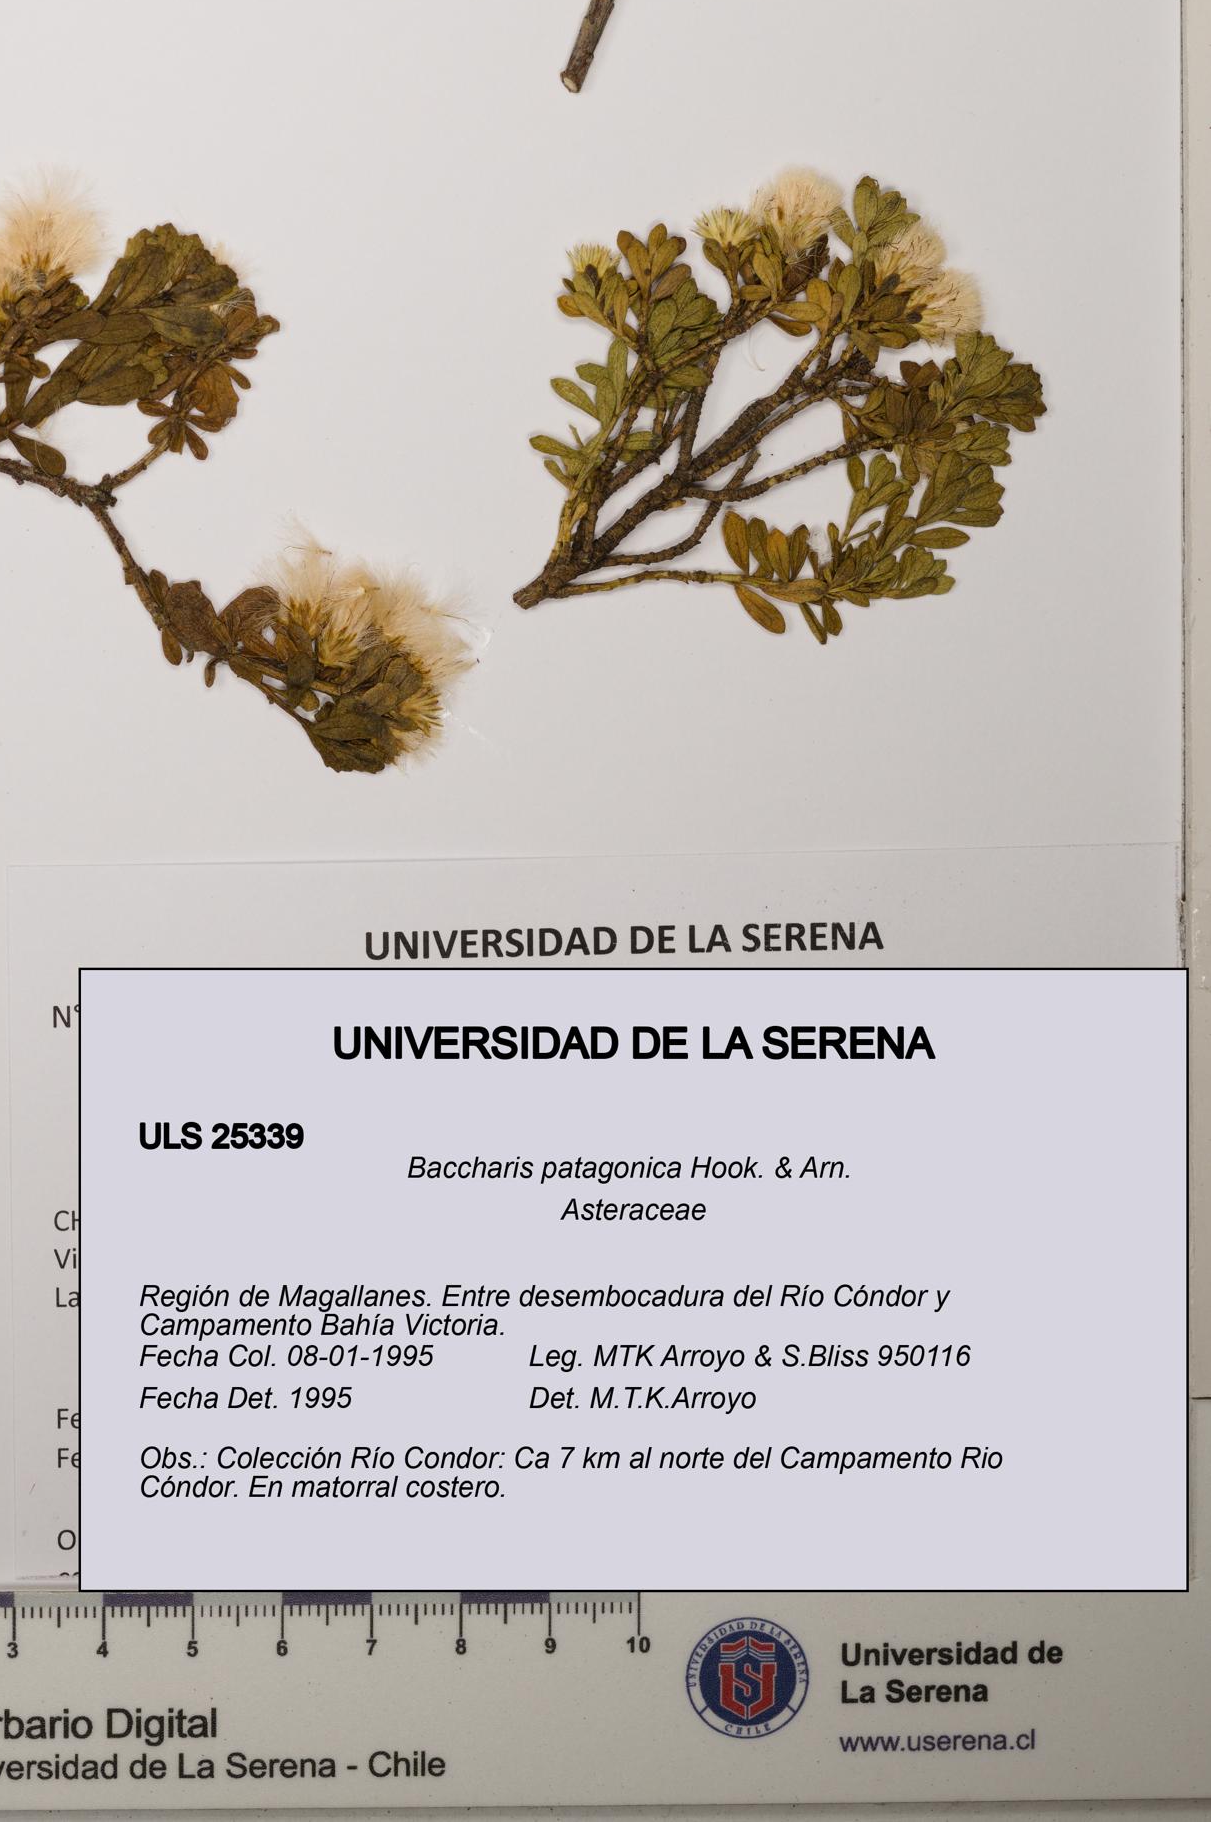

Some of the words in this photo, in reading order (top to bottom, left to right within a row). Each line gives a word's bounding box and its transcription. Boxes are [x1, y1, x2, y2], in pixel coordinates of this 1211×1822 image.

[365, 926, 618, 961] UNIVERSIDAD
[630, 924, 676, 955] DE
[688, 924, 732, 954] LA
[742, 921, 884, 953] SERENA
[6, 1641, 19, 1659] 3
[96, 1641, 110, 1659] 4
[186, 1640, 199, 1658] 5
[276, 1639, 289, 1657] 6
[365, 1638, 378, 1656] 7
[454, 1637, 467, 1656] 8
[544, 1636, 557, 1655] 9
[626, 1635, 651, 1654] 10
[841, 1640, 1018, 1667] Universidad
[1027, 1639, 1064, 1665] de
[840, 1679, 876, 1704] La
[884, 1678, 989, 1704] Serena
[106, 1707, 218, 1747] Digital
[838, 1727, 1036, 1753] www.userena.cl
[128, 1752, 168, 1780] de
[178, 1752, 215, 1780] La
[225, 1751, 336, 1780] Serena
[368, 1750, 446, 1778] Chile
